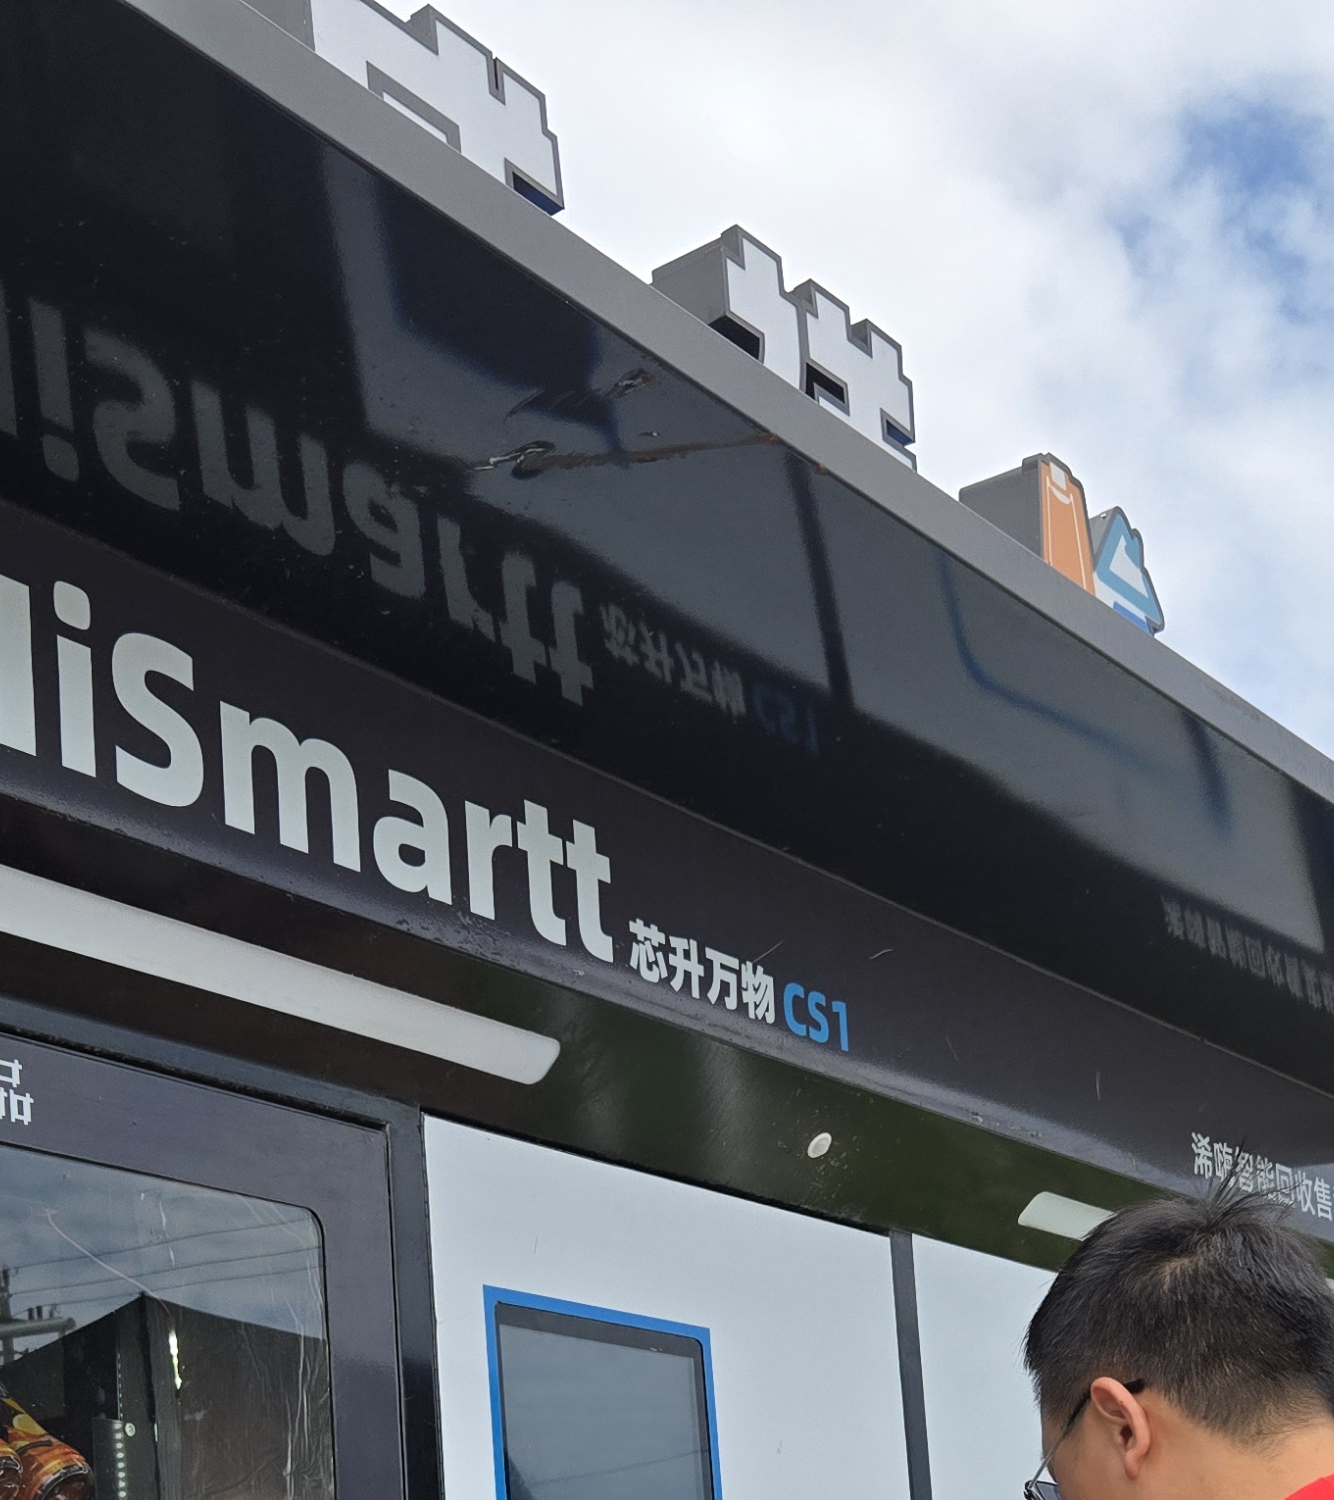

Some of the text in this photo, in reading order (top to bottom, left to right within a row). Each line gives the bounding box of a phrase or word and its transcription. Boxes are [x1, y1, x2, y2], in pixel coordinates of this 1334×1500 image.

[629, 918, 849, 1052] 芯升万物 CS1
